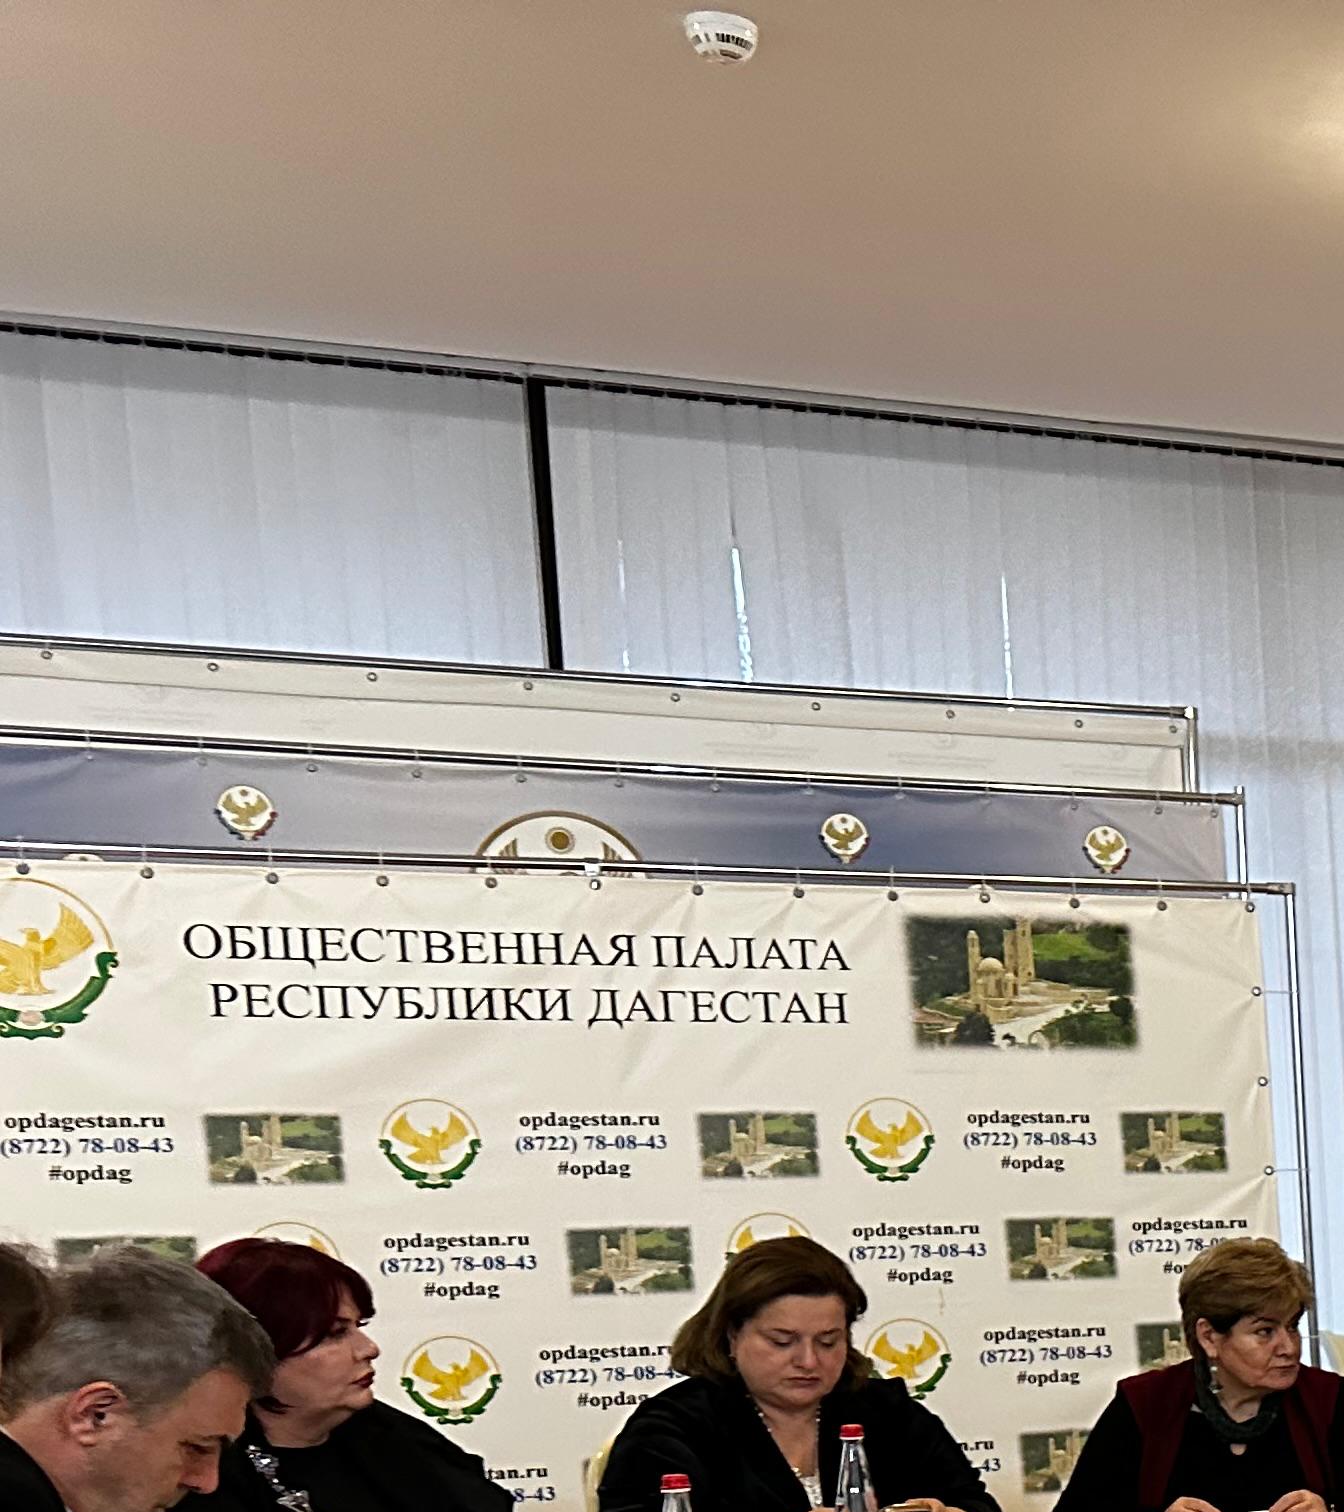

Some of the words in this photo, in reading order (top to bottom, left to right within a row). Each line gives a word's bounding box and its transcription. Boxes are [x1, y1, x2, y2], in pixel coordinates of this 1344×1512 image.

[183, 923, 637, 968] ОБЩЕСТВЕННАЯ
[652, 935, 851, 971] ПАЛАТА
[210, 983, 573, 1022] РЕСПУБЛИКИ
[588, 989, 849, 1029] ДАГЕСТАН
[4, 1112, 165, 1133] opdagestan.ru
[519, 1112, 659, 1131] opdagestan.ru
[967, 1110, 1090, 1128] opdagestan.ru
[0, 1135, 71, 1156] (8722)
[80, 1136, 174, 1154] 78-08-43
[515, 1135, 577, 1155] (8722)
[584, 1134, 668, 1153] 78-08-43
[963, 1131, 1019, 1150] (8722)
[1025, 1130, 1097, 1147] 78-08-43
[49, 1163, 132, 1184] #opdag
[558, 1159, 631, 1178] #opdag
[1000, 1155, 1065, 1173] #opdag
[852, 1221, 980, 1240] opdagestan.ru
[1132, 1217, 1248, 1235] opdagestan.ru
[384, 1231, 530, 1250] opdagestan.ru
[1128, 1238, 1180, 1256] (8722)
[849, 1244, 905, 1263] (8722)
[912, 1243, 987, 1260] 78-08-43
[380, 1254, 444, 1274] (8722)
[451, 1255, 537, 1272] 78-08-43
[887, 1267, 953, 1286] #opdag
[424, 1280, 500, 1299] #opdag
[983, 1325, 1106, 1343] opdagestan.ru
[980, 1346, 1034, 1366] (8722)
[1040, 1345, 1113, 1362] 78-08-43
[535, 1368, 597, 1388] (8722)
[1017, 1368, 1080, 1387] #opdag
